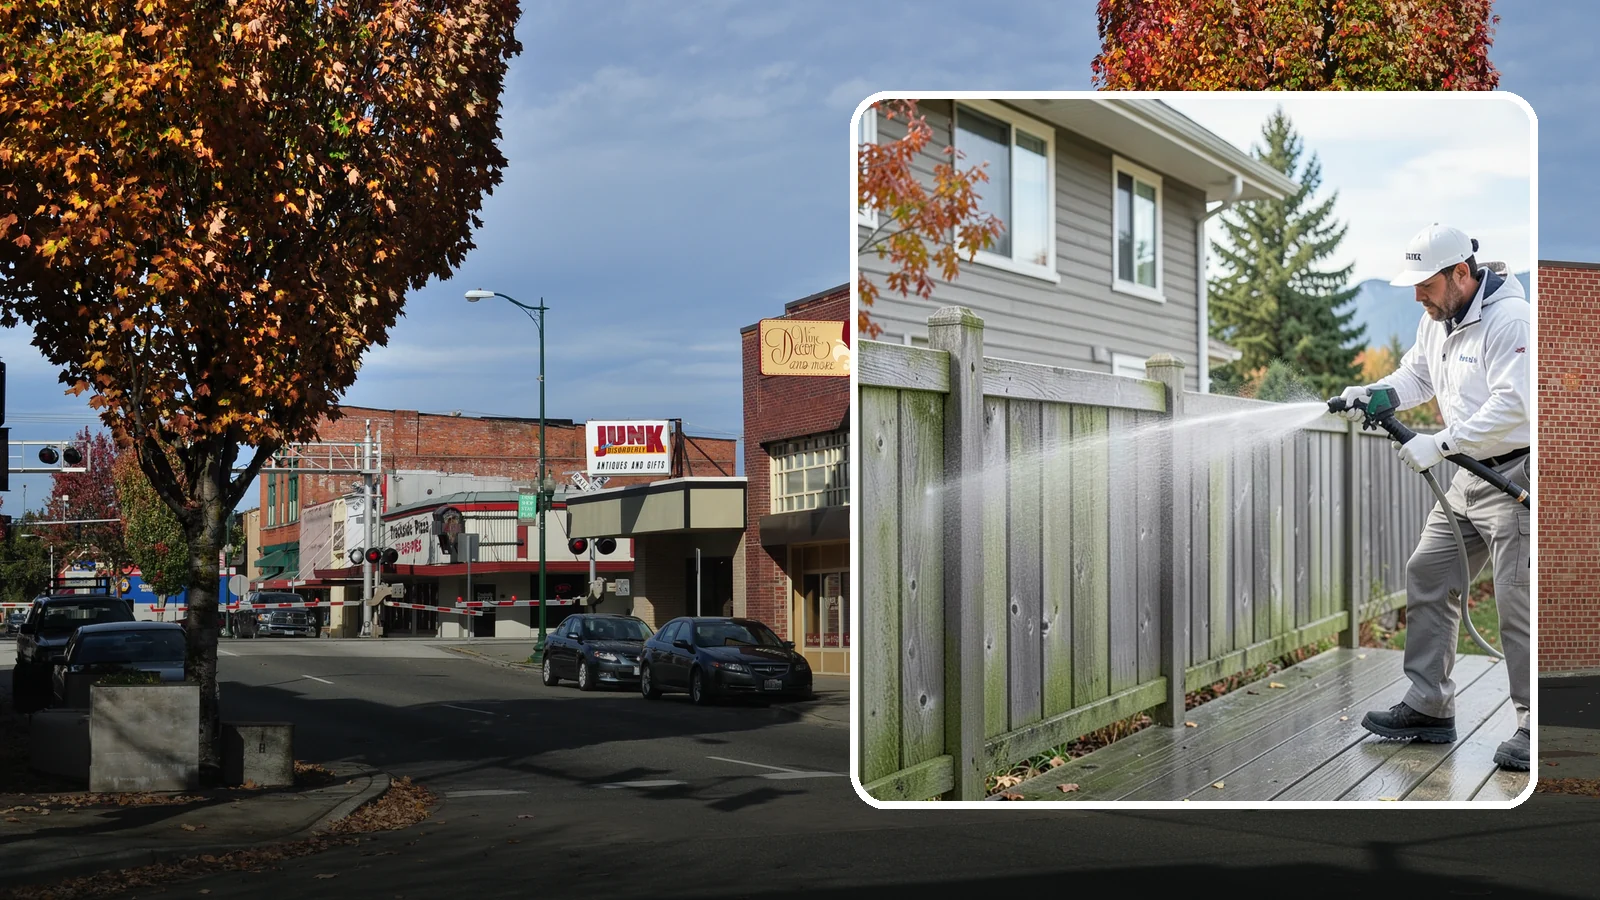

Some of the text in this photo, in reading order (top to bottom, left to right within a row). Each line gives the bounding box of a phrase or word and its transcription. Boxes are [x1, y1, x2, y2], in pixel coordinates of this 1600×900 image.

[765, 327, 831, 366] Decor
[596, 425, 665, 457] JUNK
[607, 446, 646, 454] DISORDERLY
[596, 460, 665, 470] ANTIQUES AND GIFTS
[573, 473, 589, 492] RAIL
[414, 519, 429, 535] Pizza
